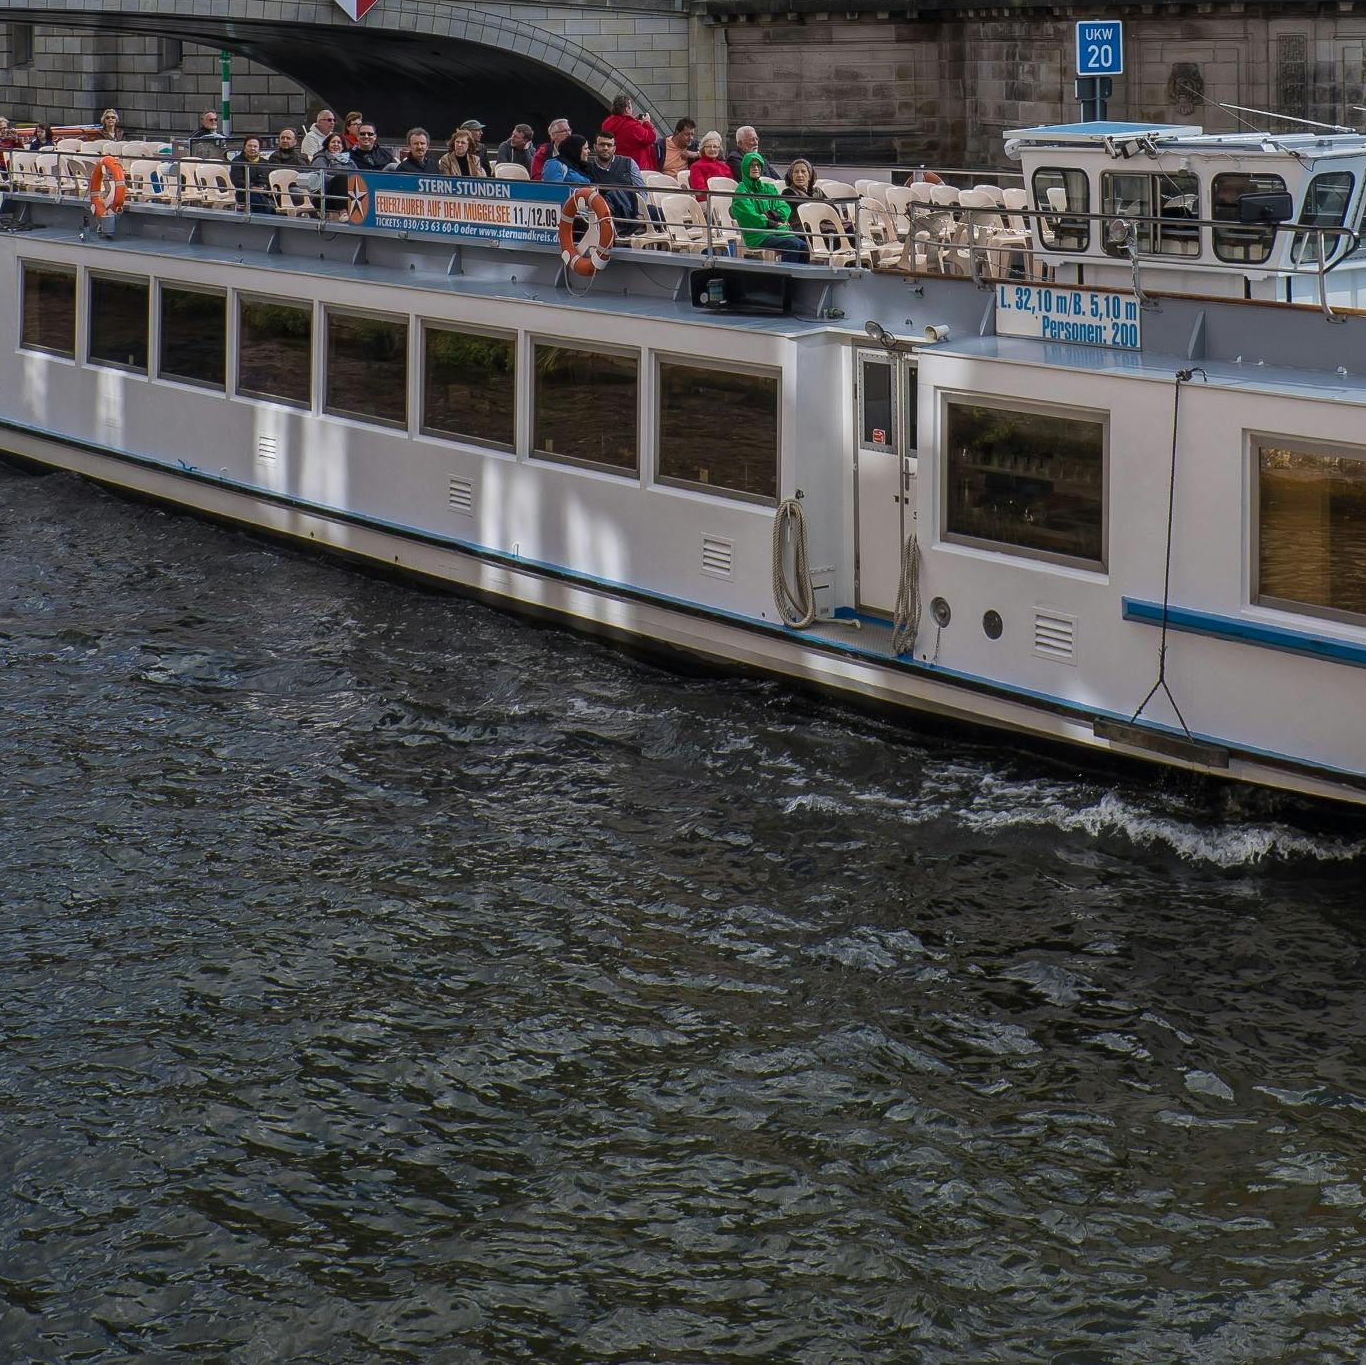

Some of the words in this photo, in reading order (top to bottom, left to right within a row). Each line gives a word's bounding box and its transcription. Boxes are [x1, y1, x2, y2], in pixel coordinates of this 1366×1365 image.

[1085, 28, 1113, 41] UKW
[1087, 44, 1113, 68] 20
[418, 178, 511, 198] STERN-STUNDEN
[376, 195, 425, 216] FEUERZAUBER
[427, 199, 441, 217] AUF
[444, 201, 461, 220] DEM
[464, 200, 511, 223] MÜGGELSEE
[375, 217, 402, 228] TICKETS:
[403, 219, 429, 231] 030/53
[430, 221, 440, 232] 63
[442, 222, 459, 233] 60-0
[460, 224, 477, 235] oder
[478, 228, 559, 242] www.sternundkreis.d
[1000, 286, 1011, 309] L.
[1015, 286, 1052, 314] 32,10
[1056, 291, 1086, 317] m/B.
[1090, 294, 1121, 321] 5,10
[1125, 301, 1137, 321] m
[1042, 315, 1107, 344] Personen:
[1111, 322, 1138, 348] 200
